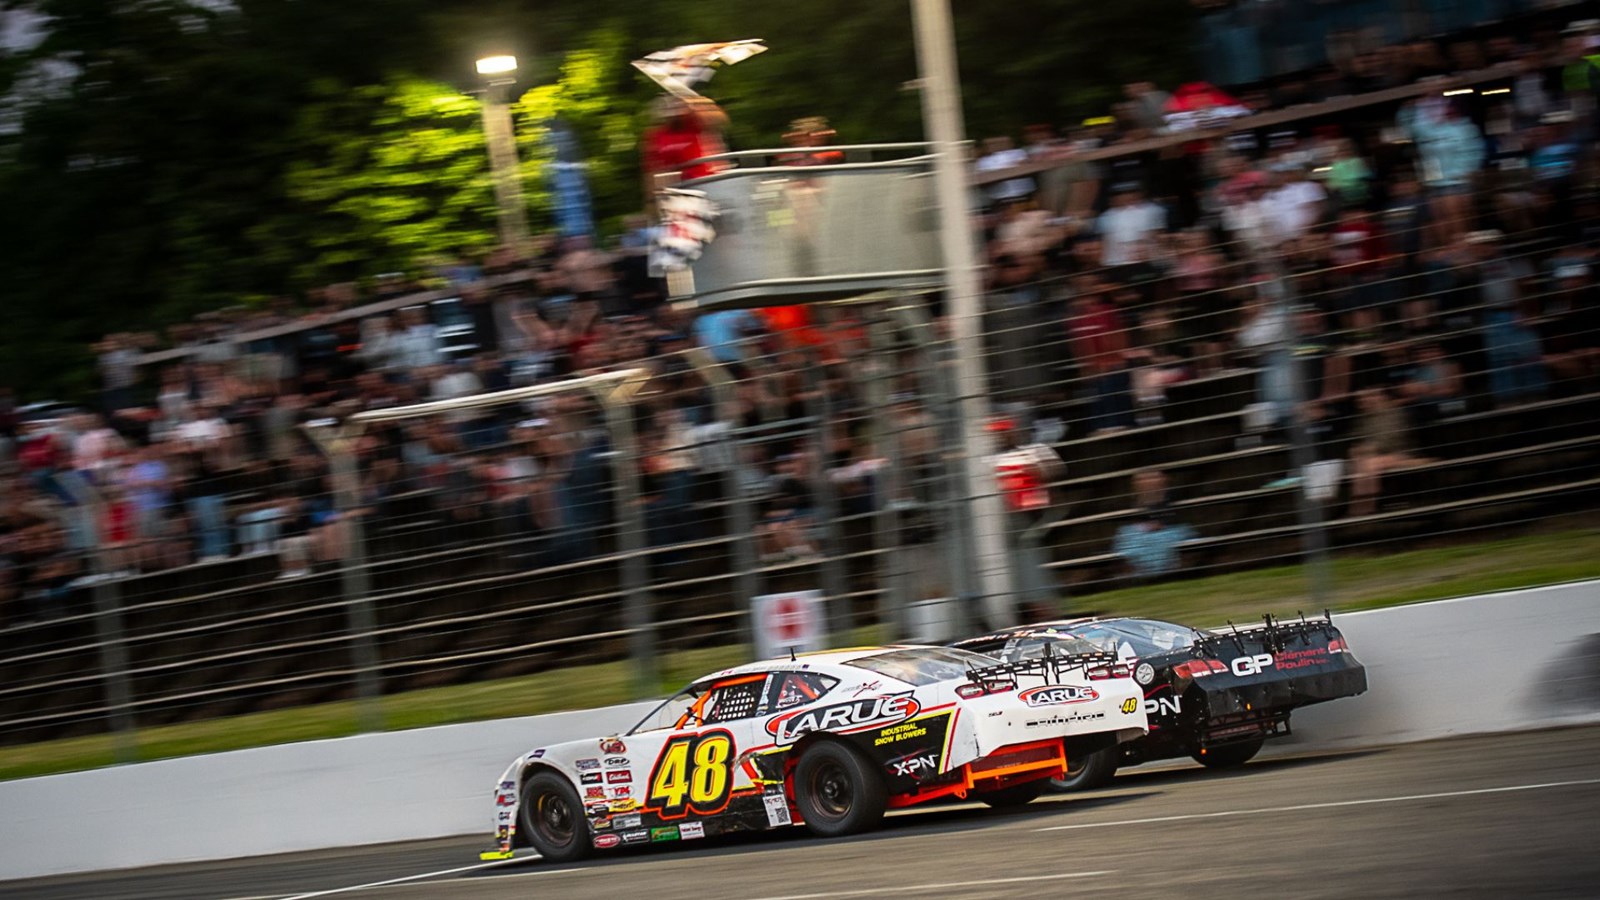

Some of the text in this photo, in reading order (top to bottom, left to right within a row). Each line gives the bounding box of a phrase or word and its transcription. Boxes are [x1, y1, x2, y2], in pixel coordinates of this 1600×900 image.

[1275, 658, 1314, 671] Poulin
[1026, 687, 1093, 707] LARUE
[1122, 697, 1137, 714] 48
[1144, 695, 1182, 716] PN
[775, 692, 914, 746] LARUE
[875, 727, 927, 746] SNOW BLOWERS
[881, 723, 918, 737] INDUSTRIAL
[650, 735, 730, 808] 48
[893, 754, 935, 776] XPN
